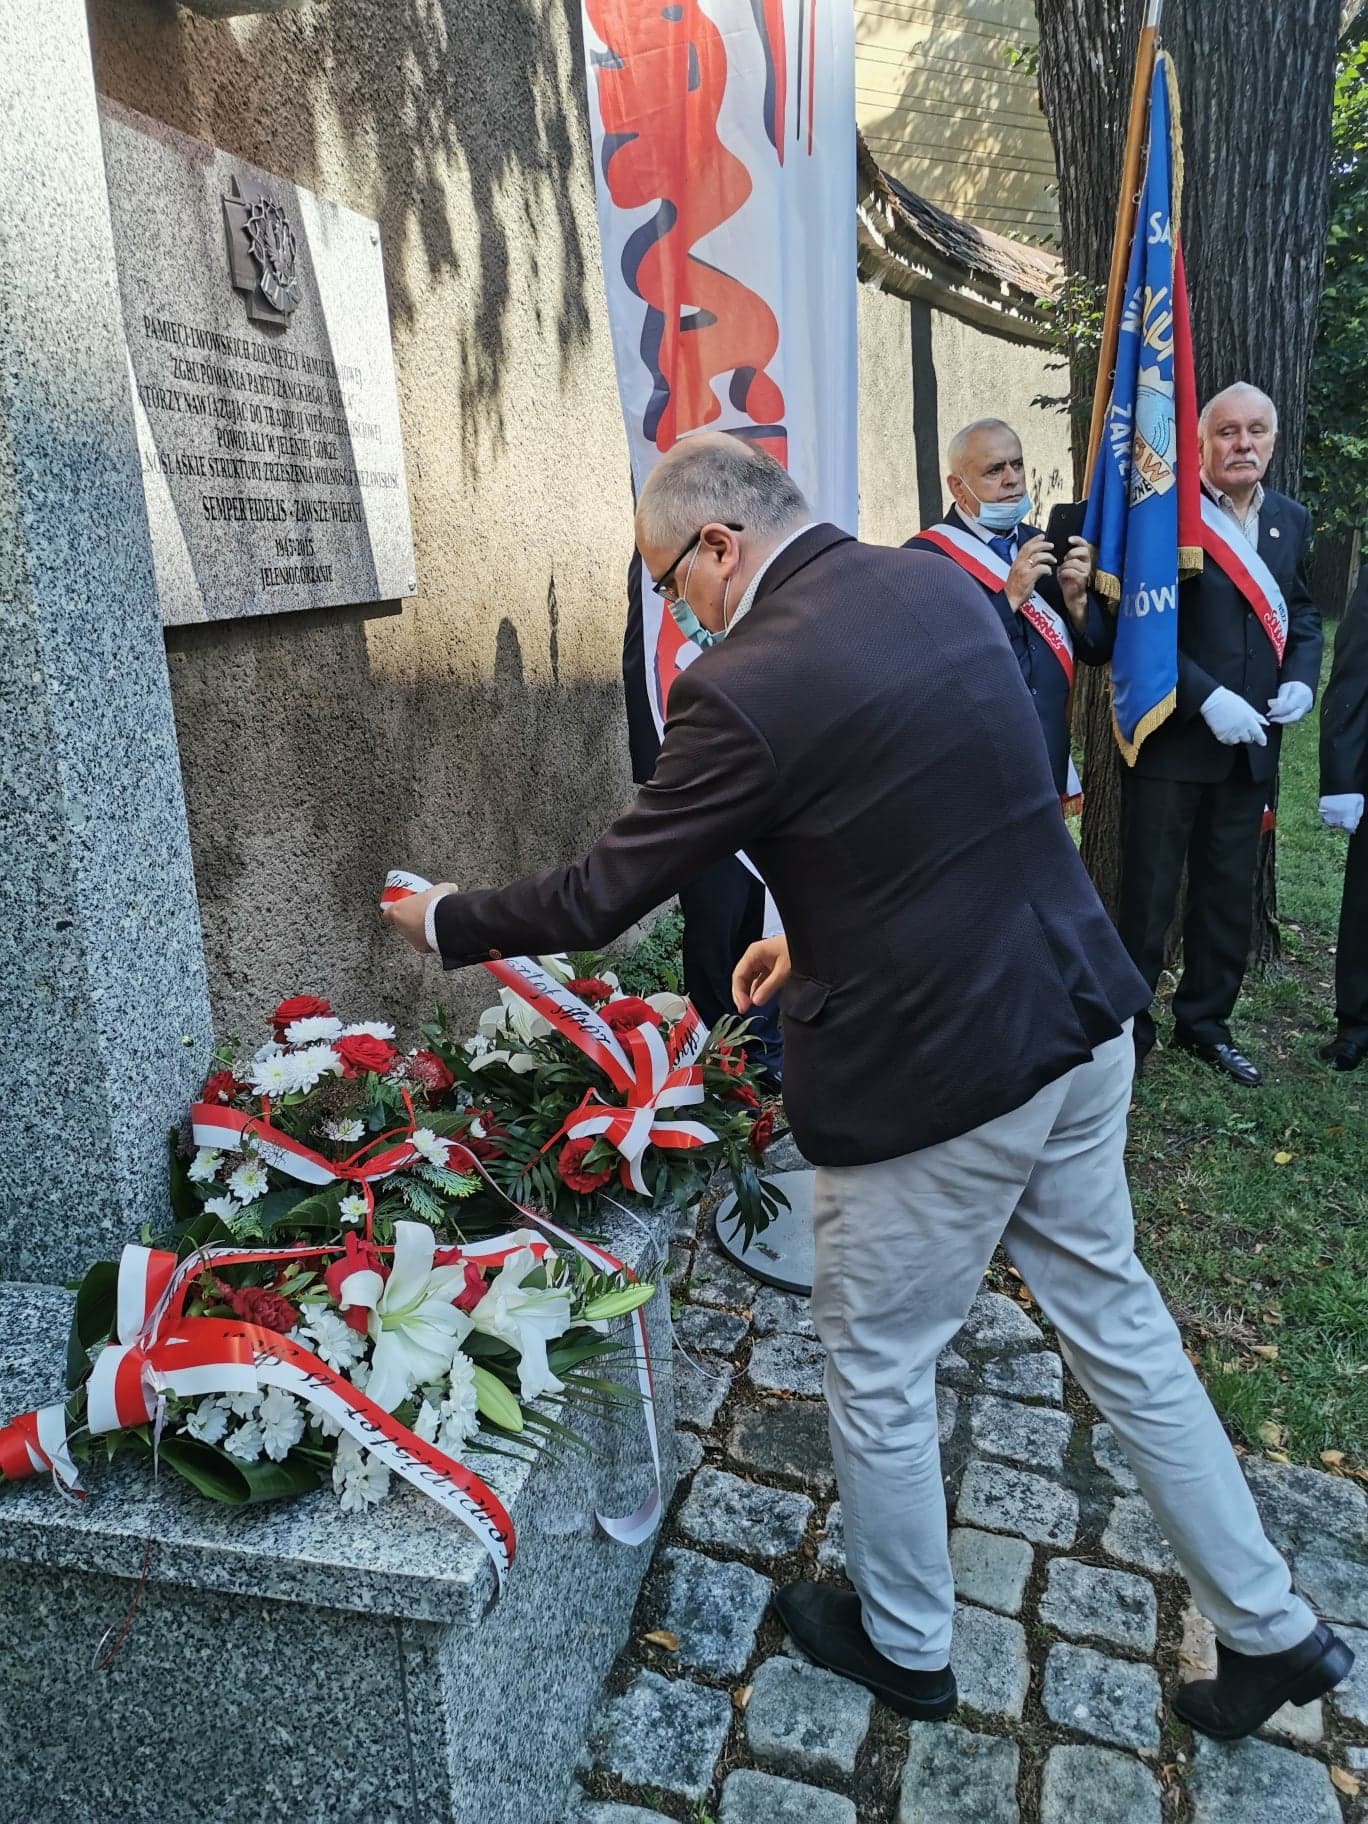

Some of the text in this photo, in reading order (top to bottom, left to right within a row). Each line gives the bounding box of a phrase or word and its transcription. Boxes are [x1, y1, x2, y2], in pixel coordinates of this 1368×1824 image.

[171, 356, 246, 391] ZGRUPOWANIA
[249, 403, 262, 424] DO
[276, 436, 312, 461] JELENIEJ
[208, 457, 262, 481] STRUKTURY
[202, 495, 363, 523] SEMPER FIDELIS ZAWSZE WIERNI
